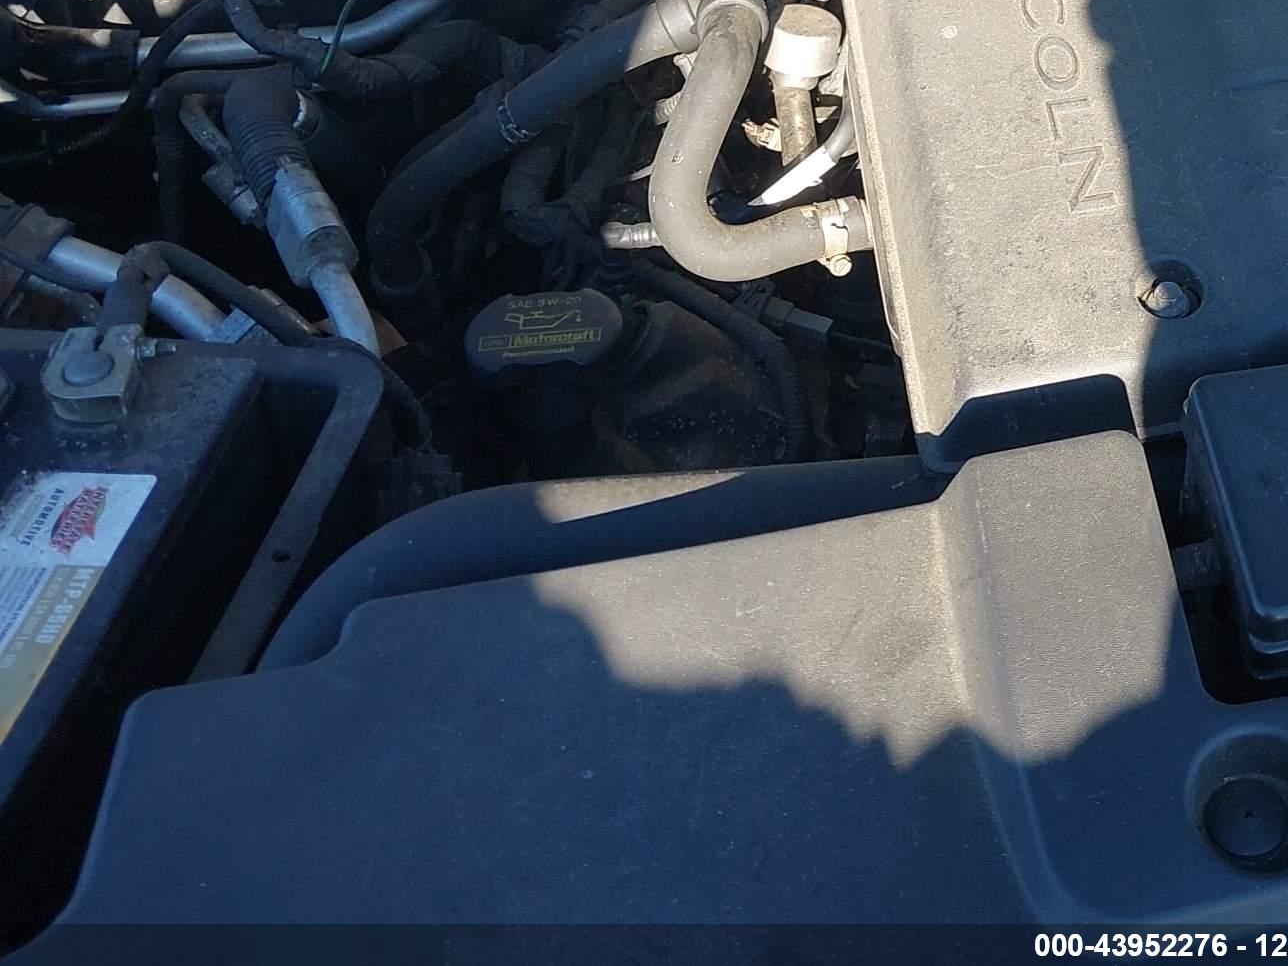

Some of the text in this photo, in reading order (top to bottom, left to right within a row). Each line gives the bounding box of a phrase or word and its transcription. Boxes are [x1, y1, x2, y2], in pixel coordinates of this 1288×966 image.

[507, 295, 583, 309] SAE 5W-20
[513, 329, 595, 347] Motorcraft
[18, 487, 65, 547] AUTOMOTIVE
[61, 485, 109, 554] INTERSTATE
